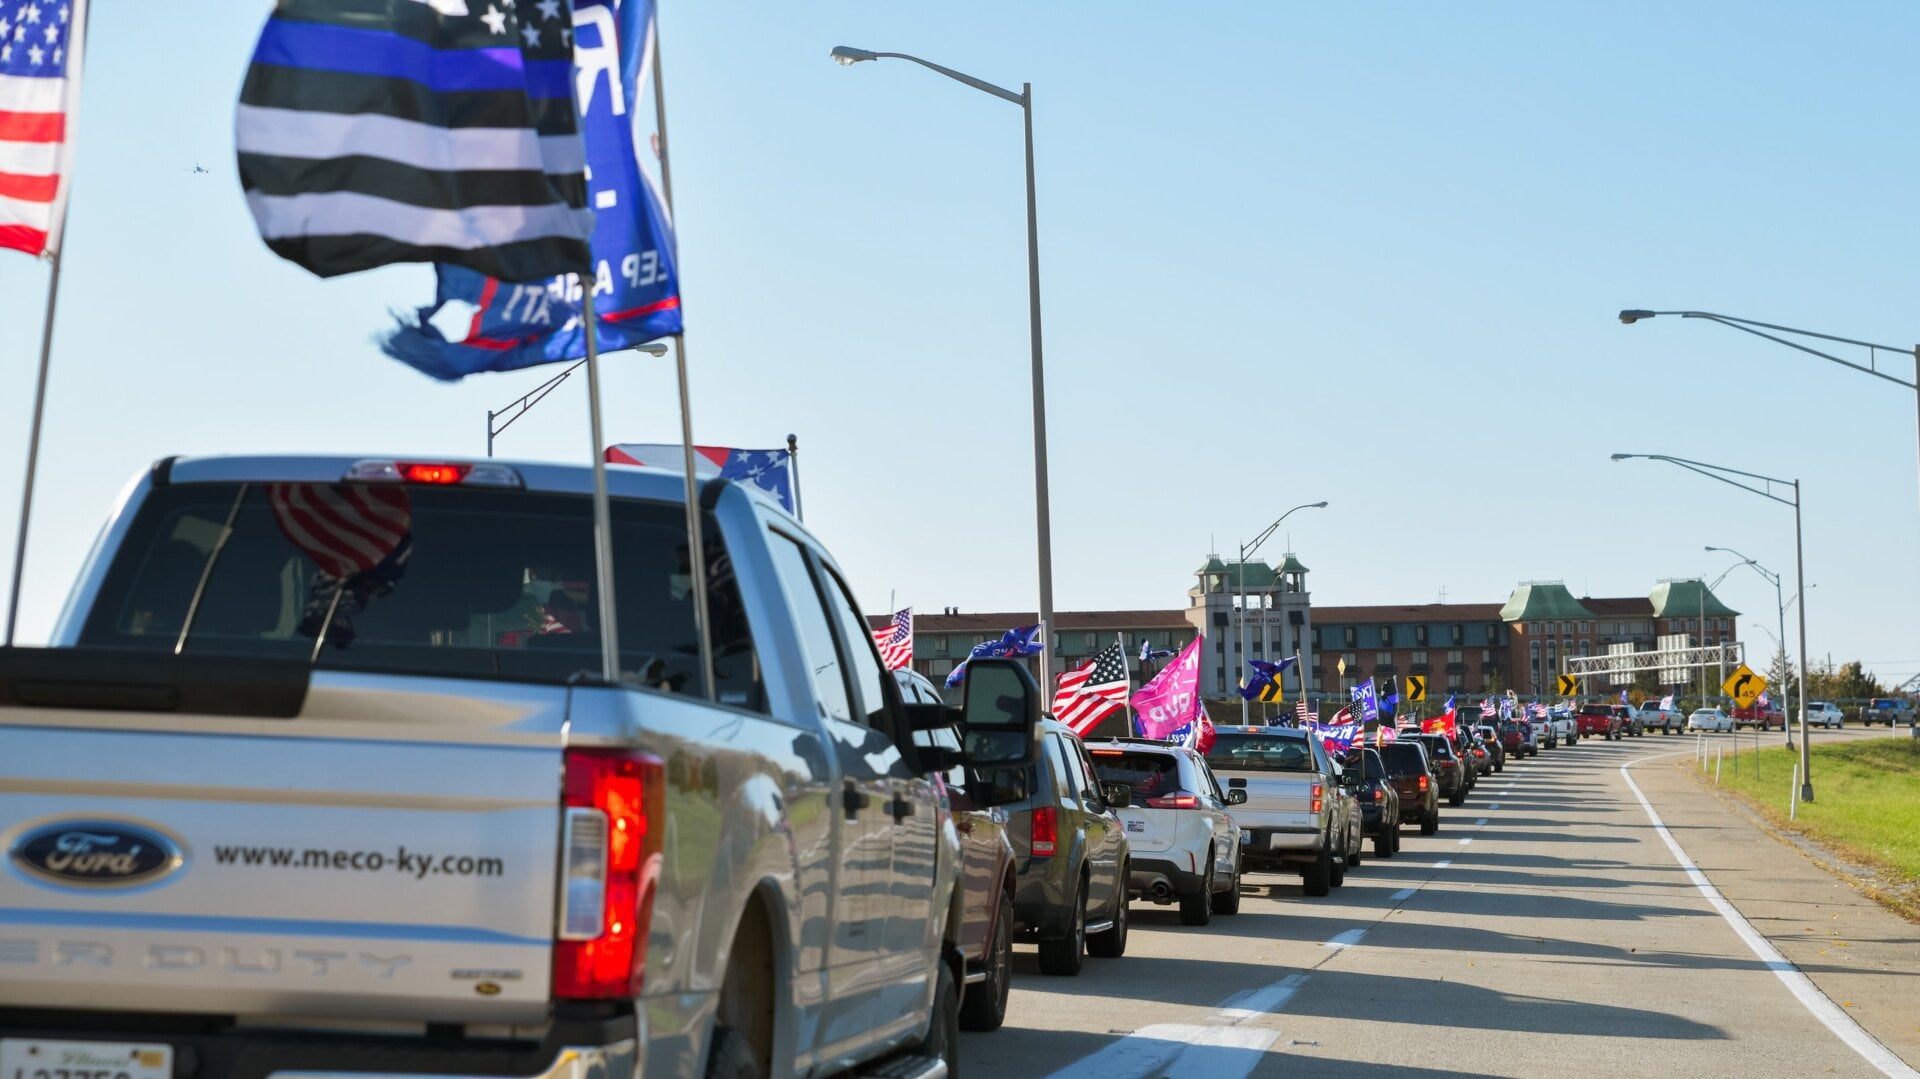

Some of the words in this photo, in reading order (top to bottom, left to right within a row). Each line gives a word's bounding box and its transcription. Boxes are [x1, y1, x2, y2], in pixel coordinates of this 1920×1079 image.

[1742, 690, 1756, 698] 45
[46, 832, 141, 875] Ford
[214, 844, 505, 879] www.meco-ky.com
[144, 943, 413, 978] DUTY
